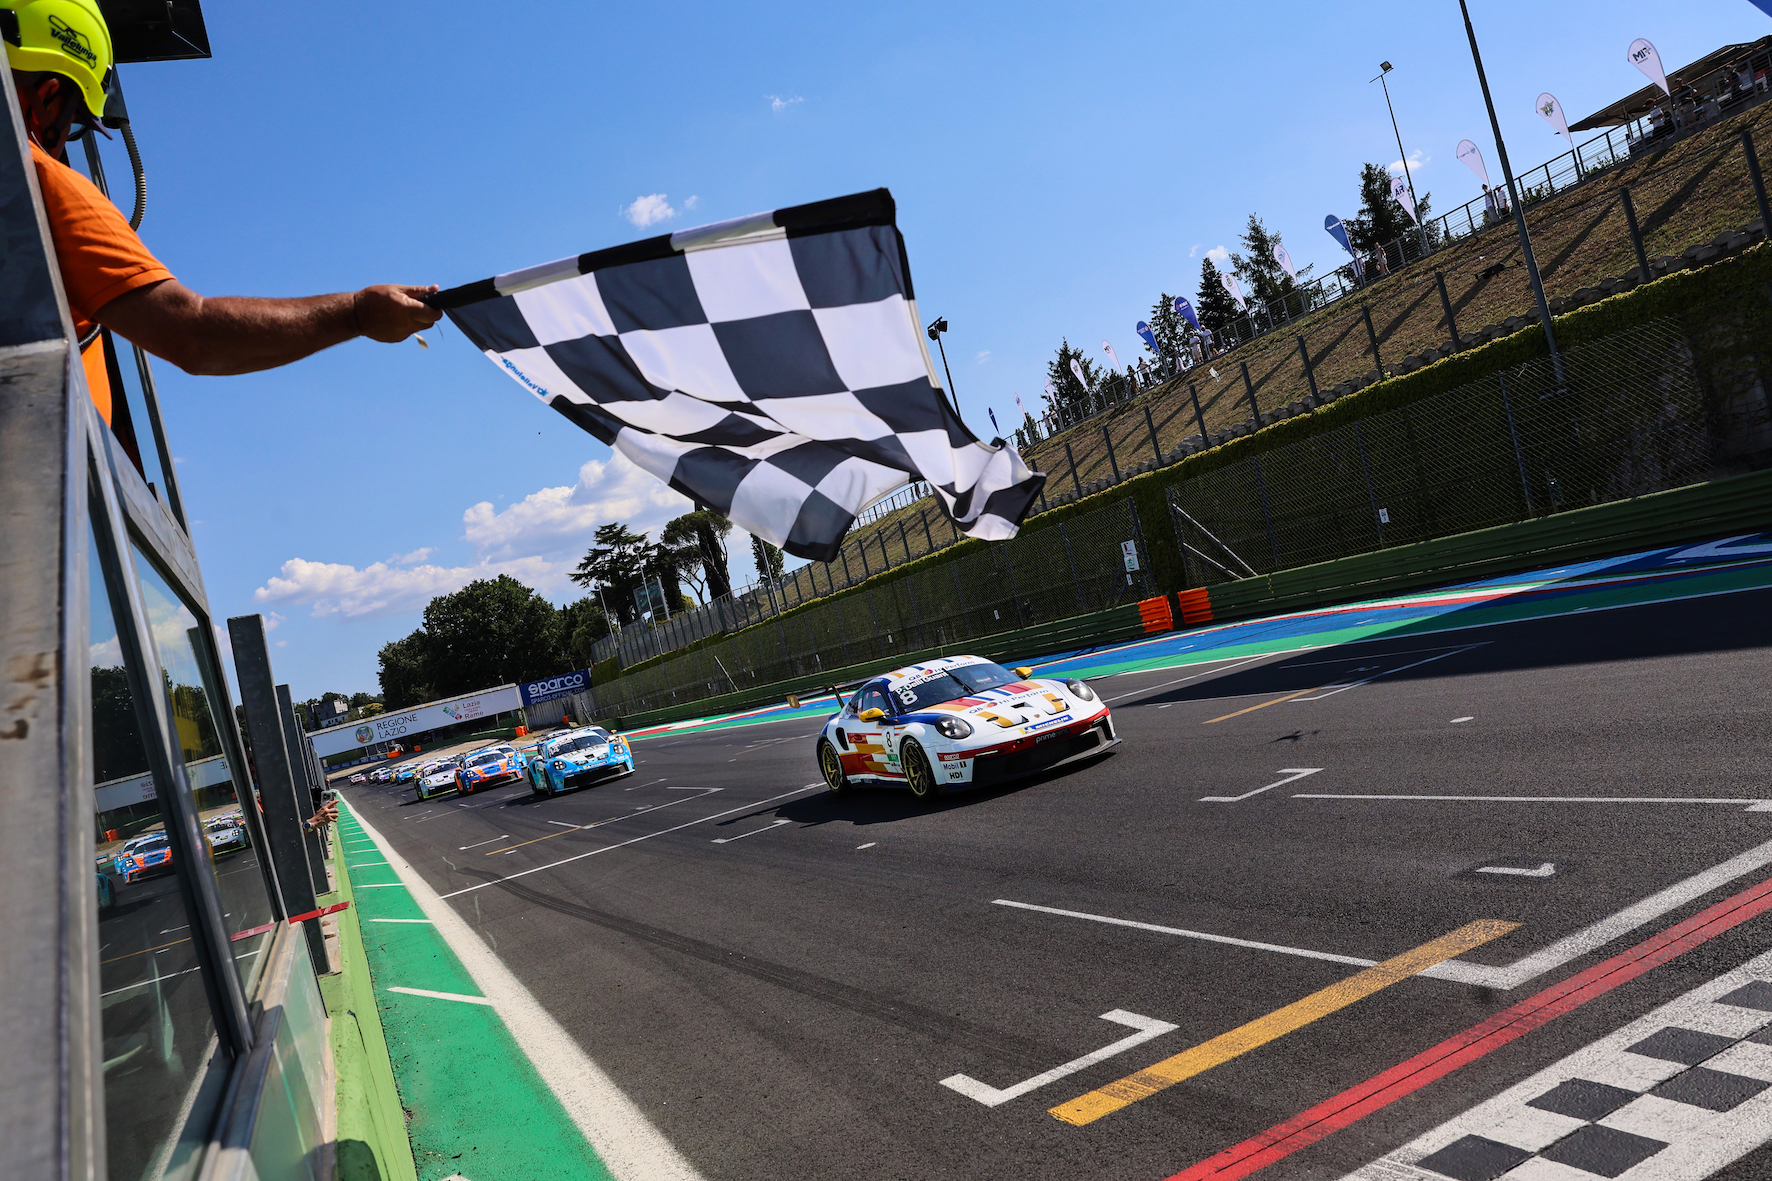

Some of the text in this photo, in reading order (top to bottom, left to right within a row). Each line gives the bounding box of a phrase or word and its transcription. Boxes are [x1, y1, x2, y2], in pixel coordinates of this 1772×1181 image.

[51, 27, 98, 62] Vallelunga
[528, 674, 583, 696] sparco
[530, 687, 586, 704] SPARCO-OFFICIL.COM
[900, 690, 919, 706] 8
[1011, 690, 1049, 701] Perform
[462, 700, 481, 709] Lazio
[376, 713, 418, 730] REGIONE
[1035, 716, 1069, 729] MICHELIN
[378, 725, 407, 739] LAZIO
[886, 731, 893, 747] 8
[943, 762, 960, 770] Mobil
